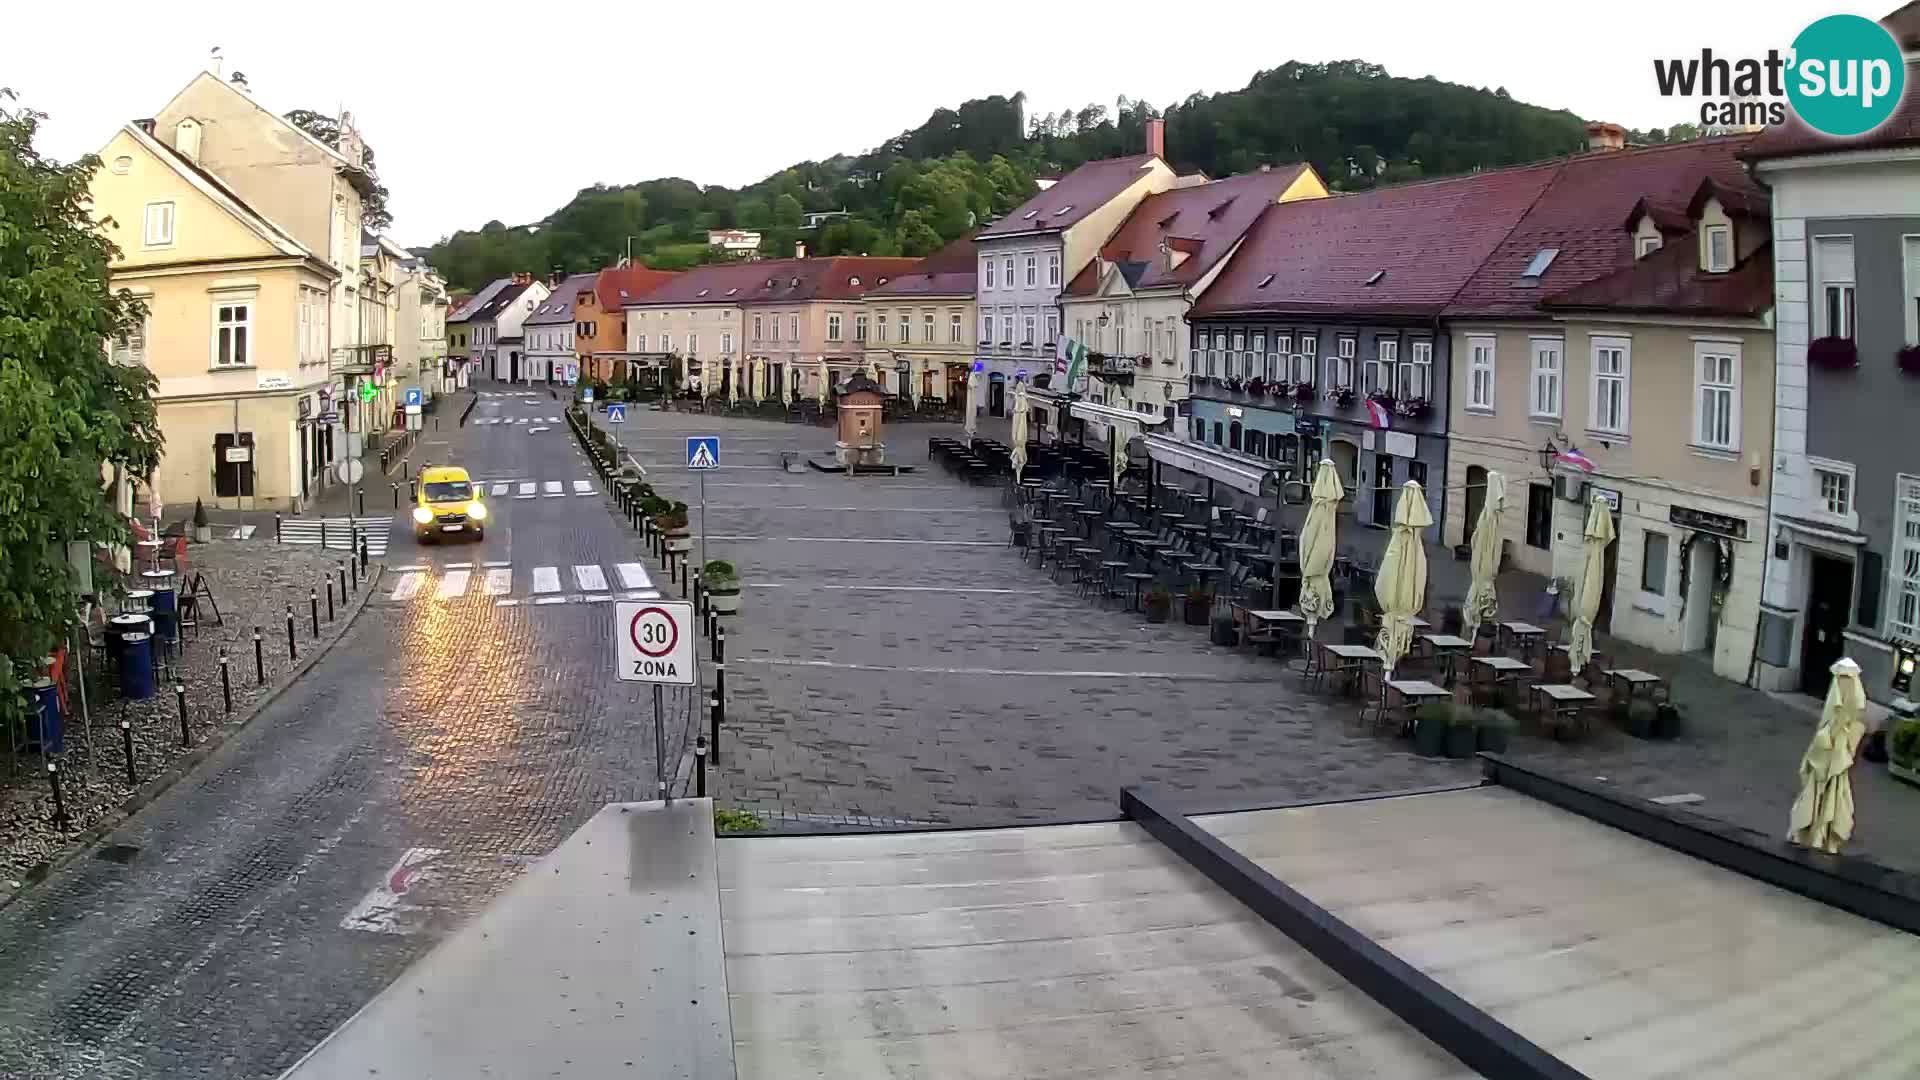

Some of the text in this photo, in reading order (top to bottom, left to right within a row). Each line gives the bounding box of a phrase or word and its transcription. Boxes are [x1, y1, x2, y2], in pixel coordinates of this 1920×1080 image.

[409, 392, 417, 402] P
[643, 623, 667, 644] 30
[633, 660, 677, 677] ZONA
